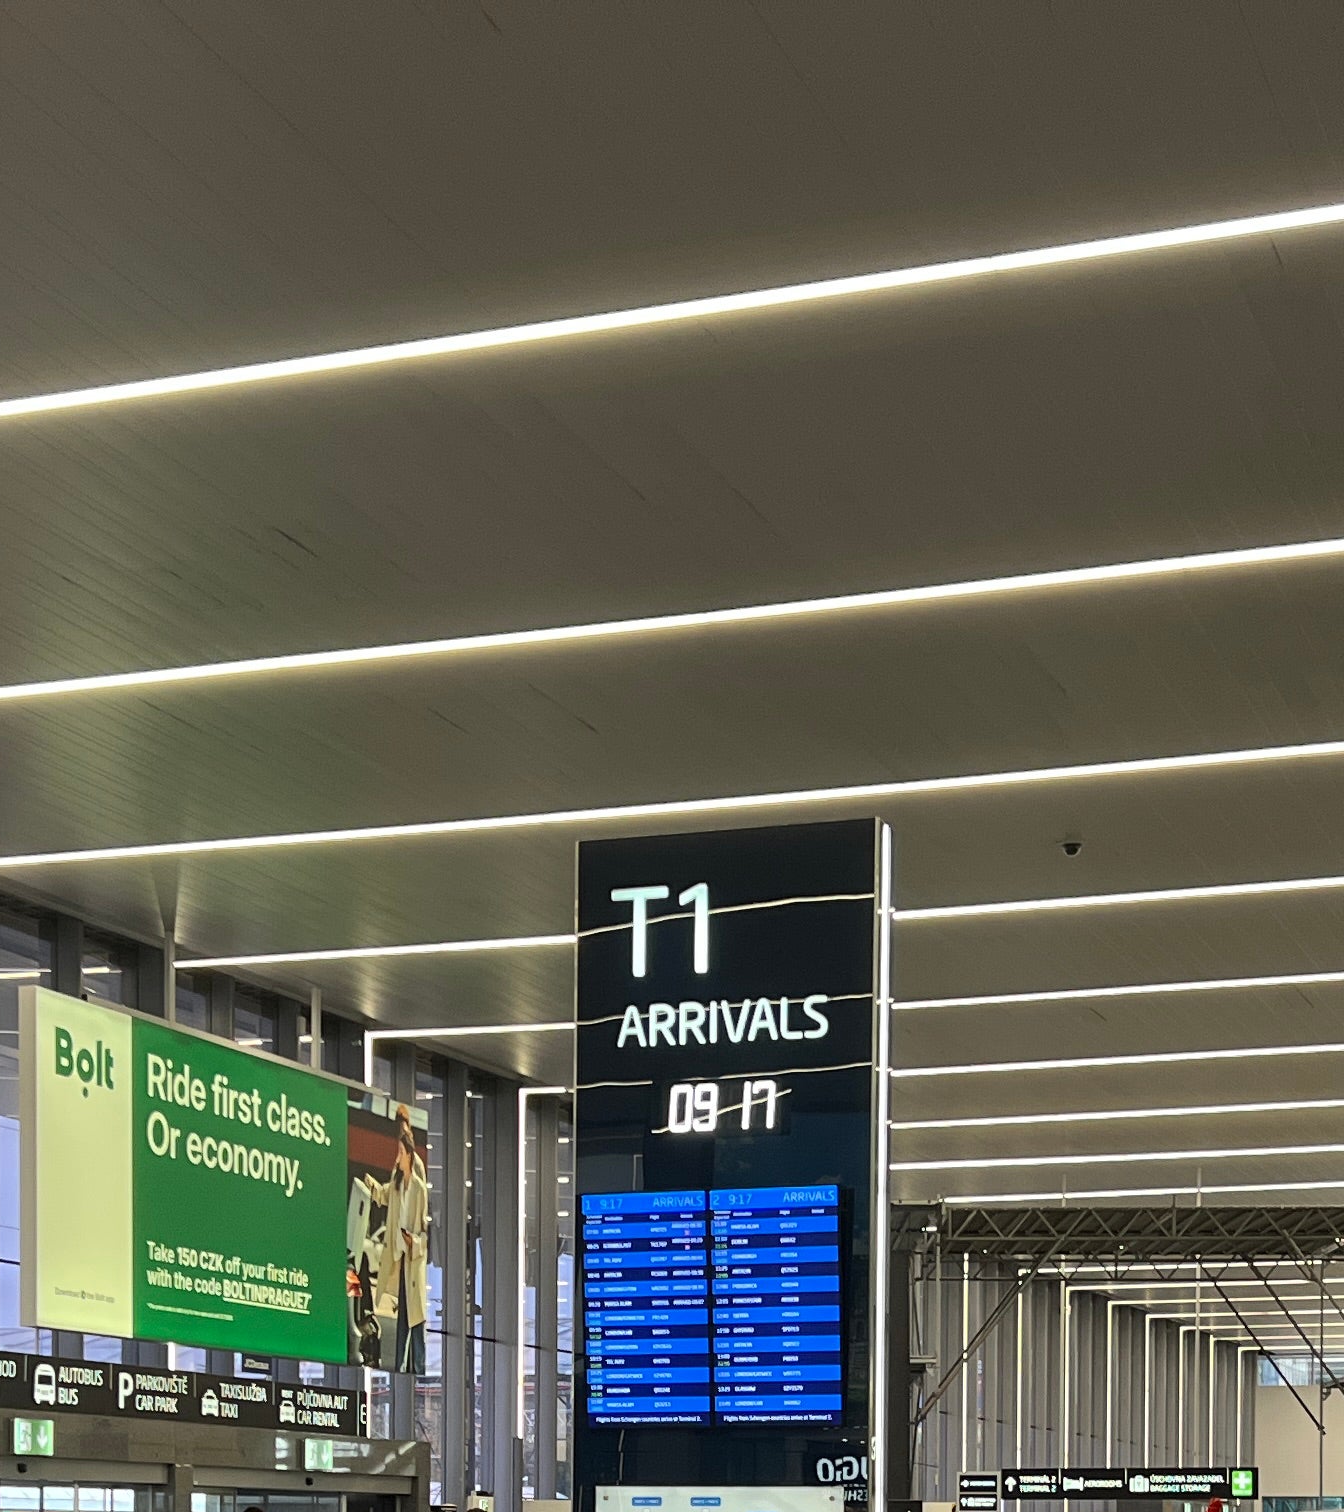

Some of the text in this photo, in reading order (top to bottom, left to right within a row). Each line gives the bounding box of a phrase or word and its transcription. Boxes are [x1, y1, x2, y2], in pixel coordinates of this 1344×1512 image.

[611, 882, 710, 978] T1
[617, 994, 830, 1048] ARRIVALS
[55, 1026, 115, 1098] Bolt
[147, 1052, 331, 1147] Ride first class.
[146, 1110, 304, 1198] Or economy.
[653, 1195, 703, 1208] ARRIVALS
[713, 1190, 835, 1206] 2 9:17 ARRIVALS
[146, 1240, 309, 1287] Take 150 CZK off your first ride
[146, 1267, 173, 1290] with
[174, 1274, 193, 1292] the
[194, 1277, 222, 1297] code
[59, 1366, 104, 1387] AUTOBUS
[118, 1372, 134, 1409] P
[135, 1373, 188, 1395] PARKOVIŠTĚ
[219, 1382, 268, 1403] TAXISLUŽBA
[59, 1387, 79, 1406] BUS
[135, 1395, 155, 1411] CAR
[155, 1396, 179, 1414] PARK
[220, 1402, 239, 1419] TAXI
[297, 1410, 312, 1425] CAR
[1019, 1474, 1050, 1483] TERMINÁL
[1019, 1484, 1050, 1493] TERMINAL
[1150, 1484, 1180, 1493] BAGGAGE
[1181, 1484, 1212, 1493] STORAGE
